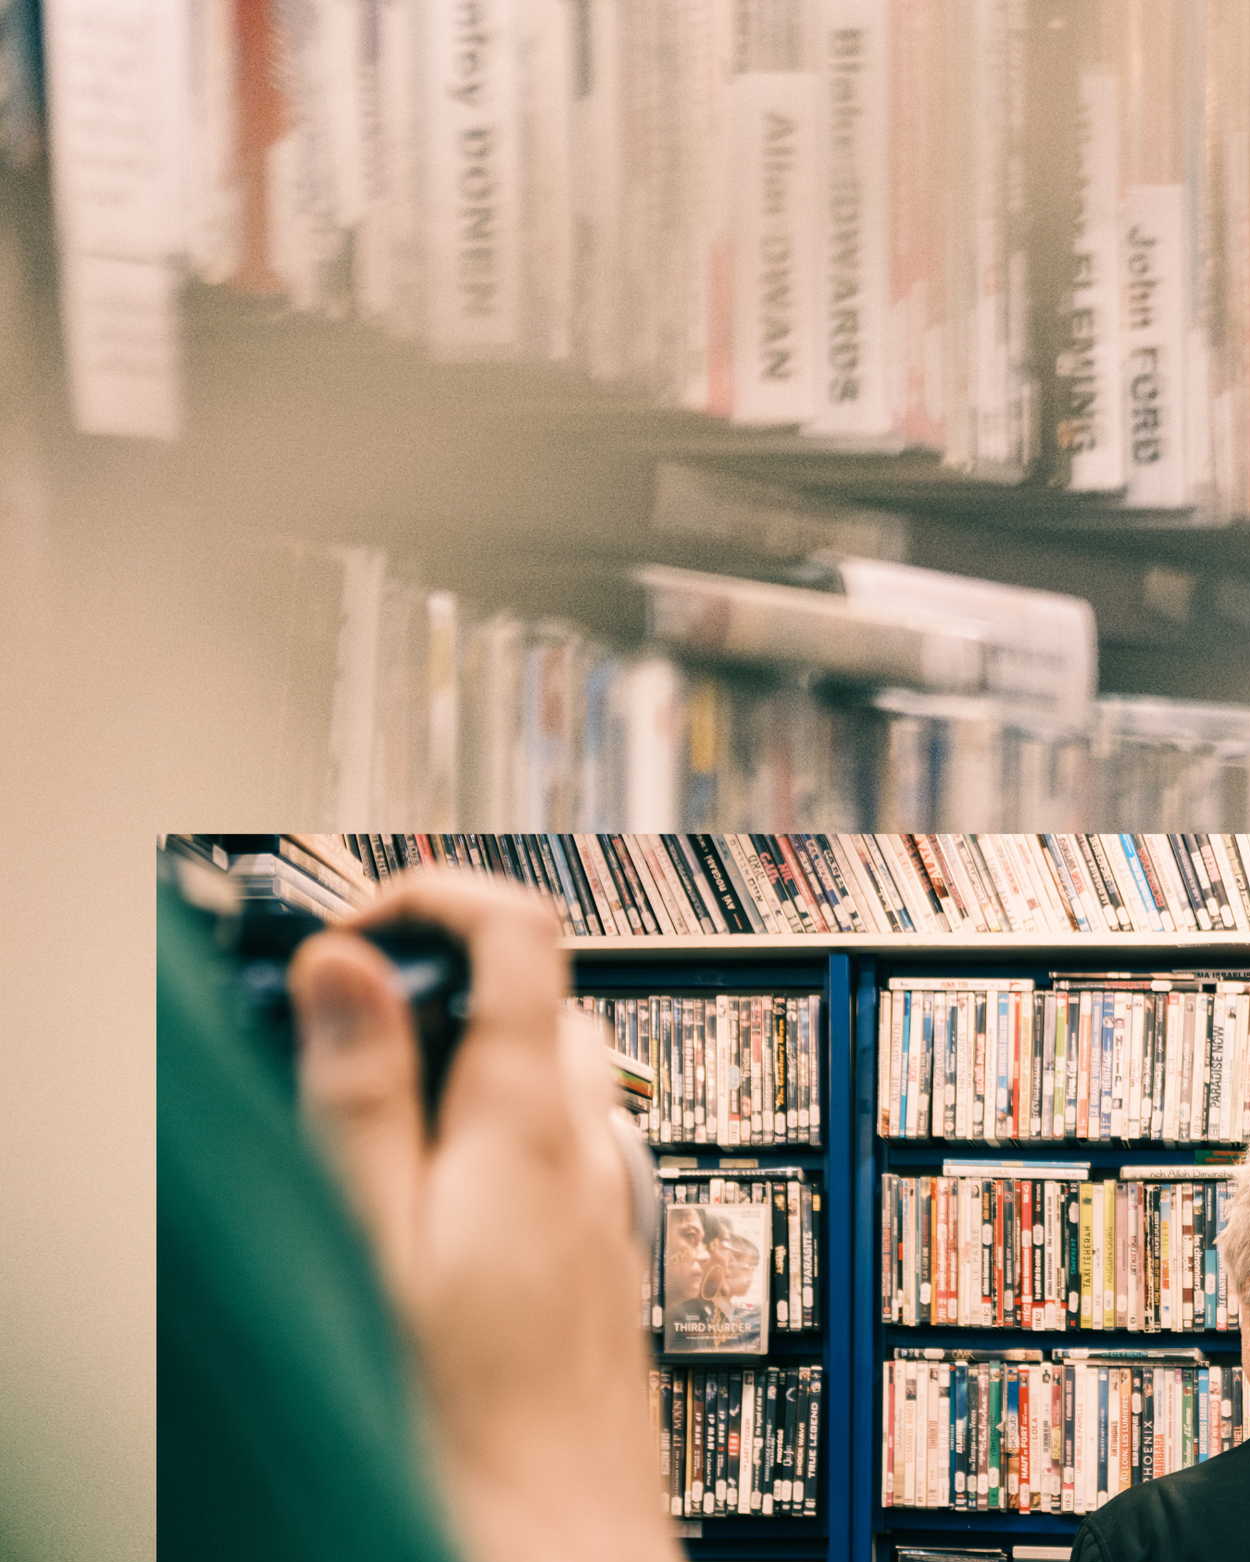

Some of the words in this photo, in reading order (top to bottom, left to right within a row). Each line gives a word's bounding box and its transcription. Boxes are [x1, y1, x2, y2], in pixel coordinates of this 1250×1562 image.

[458, 127, 499, 318] DONEN
[1128, 226, 1162, 330] John
[758, 234, 795, 384] DWAN
[1131, 346, 1164, 466] FORD
[1211, 1025, 1224, 1052] NOW
[685, 1040, 694, 1100] CHAMPION
[908, 1055, 917, 1082] BOSTA
[1090, 1047, 1100, 1078] VOYAGE
[1090, 1080, 1100, 1106] GRAND
[1211, 1055, 1224, 1108] PARADISE
[1168, 1169, 1191, 1178] Allah
[1192, 1169, 1234, 1178] Dimanche
[1105, 1227, 1113, 1253] OURS
[803, 1232, 813, 1284] PARASITE
[1105, 1256, 1113, 1284] AUCUN
[1082, 1268, 1091, 1288] TAXI
[673, 1322, 706, 1333] THIRD
[808, 1403, 818, 1446] LEGEND
[928, 1421, 937, 1450] TIMBUKTU
[1052, 1426, 1061, 1459] RAZZIA
[1155, 1434, 1164, 1476] BARBARA
[808, 1449, 818, 1478] TRUE
